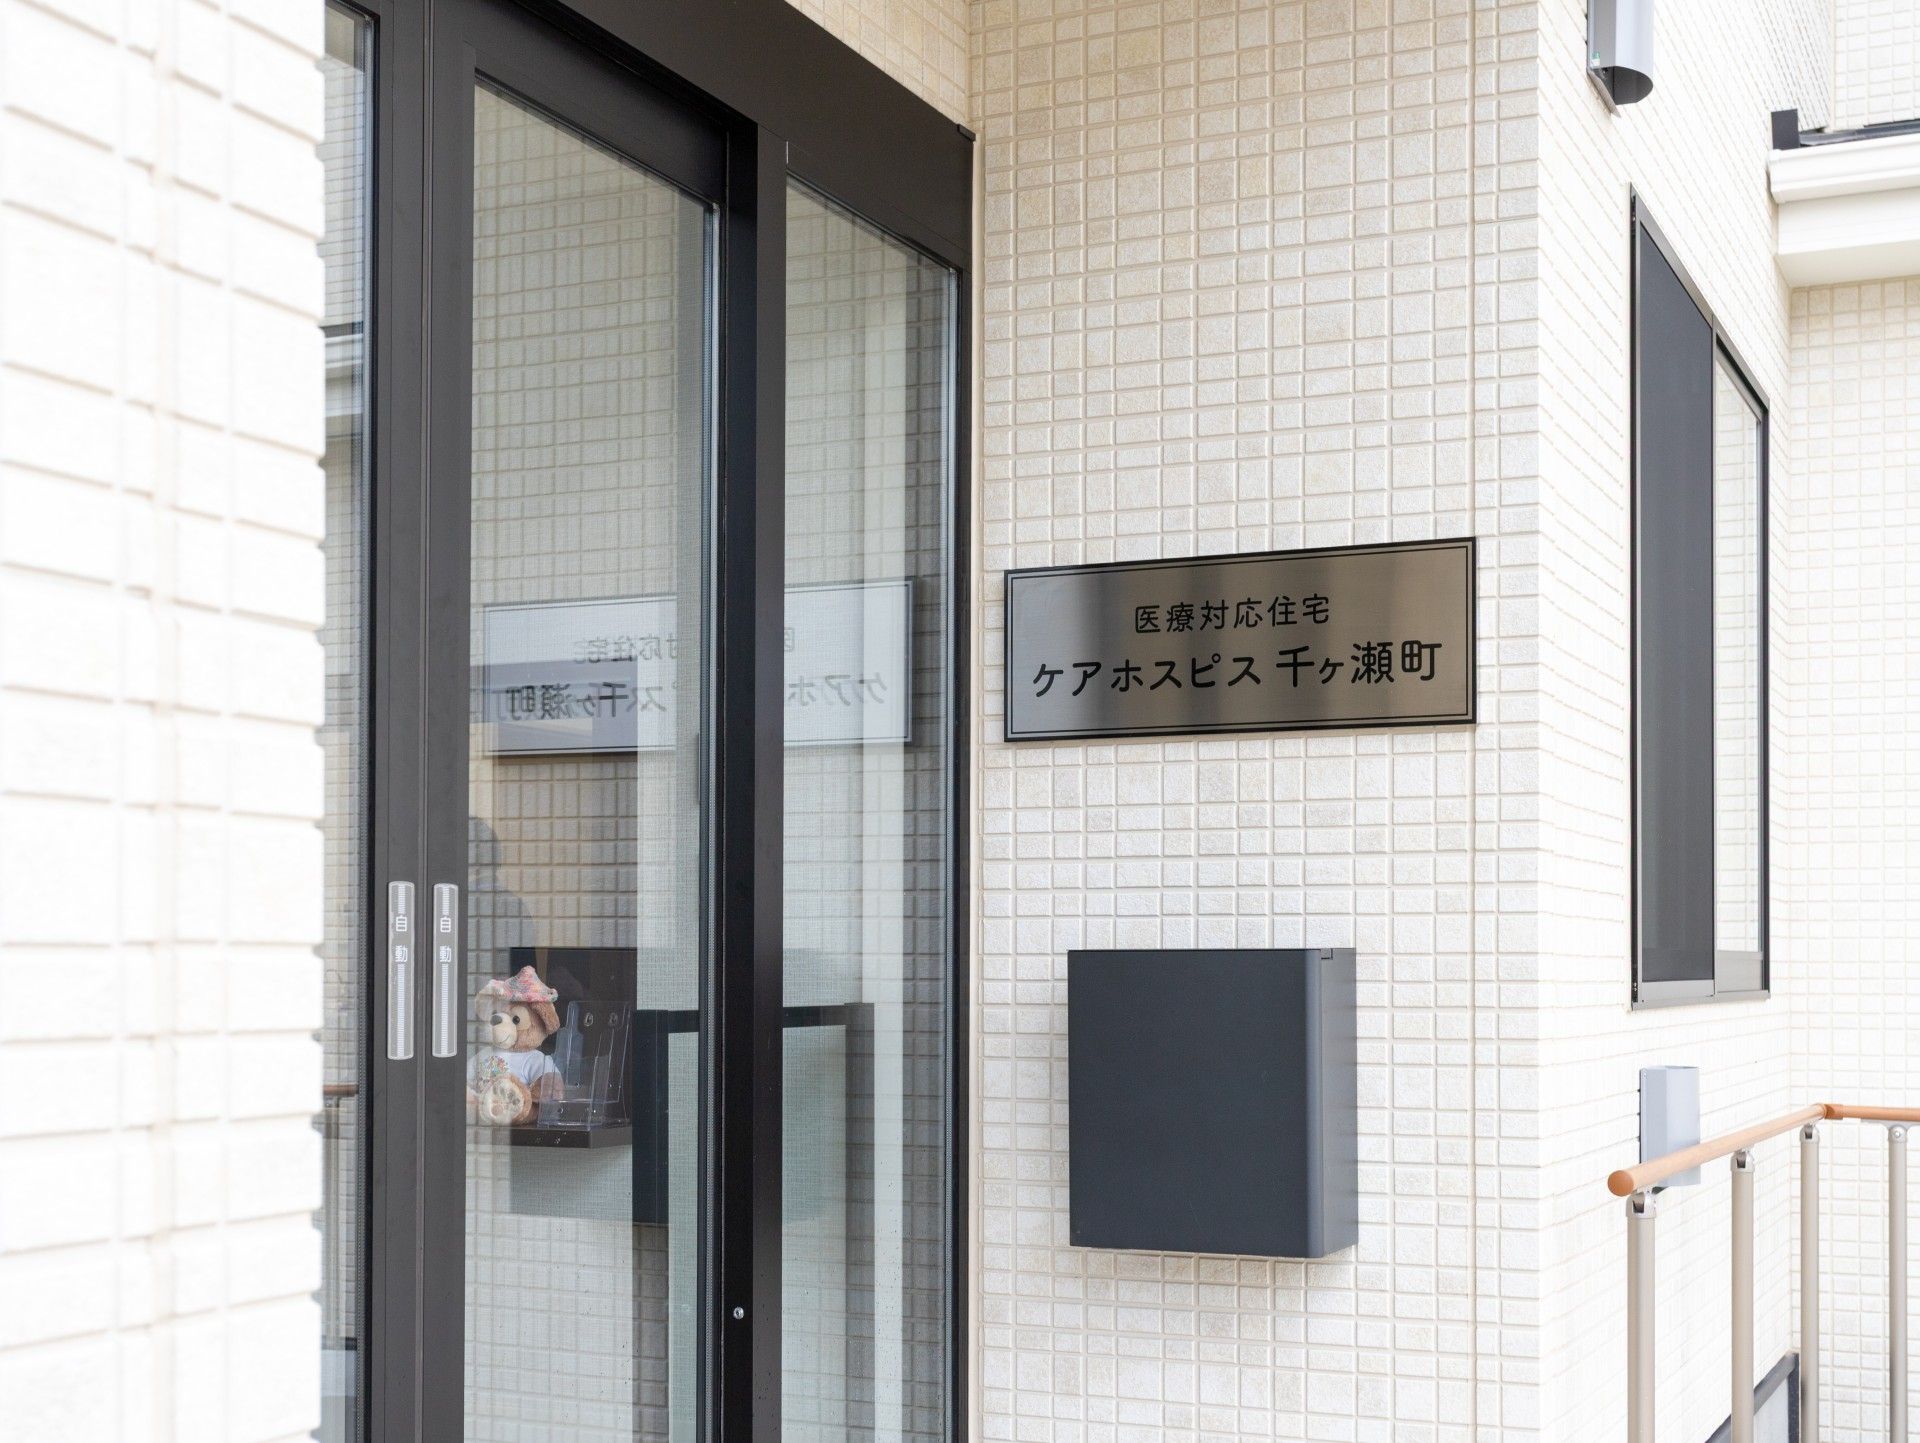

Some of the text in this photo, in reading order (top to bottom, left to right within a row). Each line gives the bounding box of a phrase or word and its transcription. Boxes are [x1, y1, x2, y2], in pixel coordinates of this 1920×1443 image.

[1135, 593, 1330, 634] 医療対応住宅
[395, 915, 408, 963] 自動
[440, 916, 452, 963] 自動
